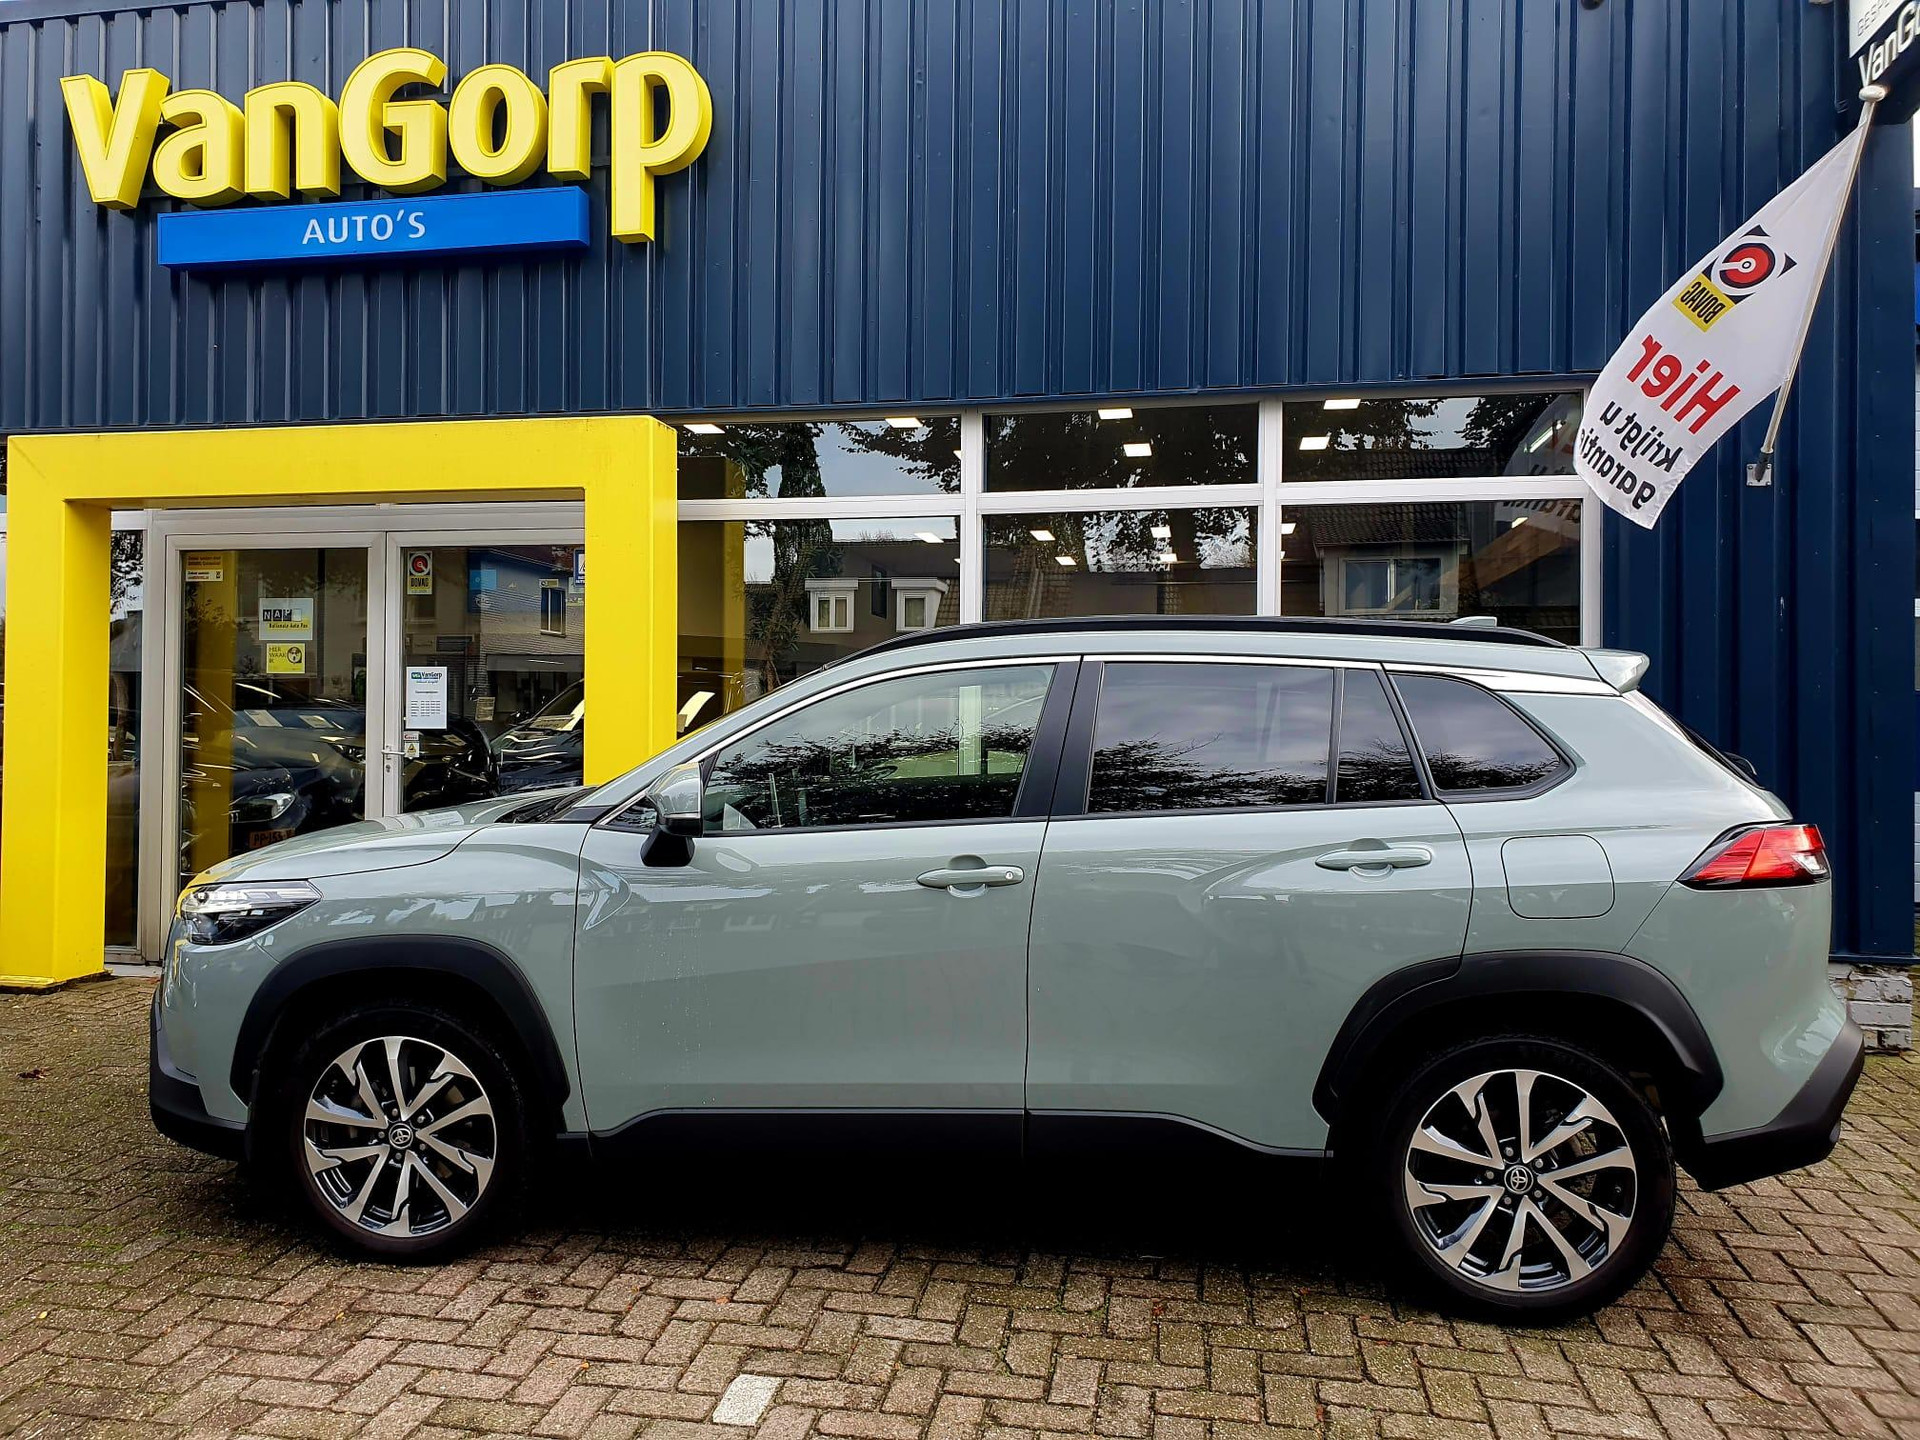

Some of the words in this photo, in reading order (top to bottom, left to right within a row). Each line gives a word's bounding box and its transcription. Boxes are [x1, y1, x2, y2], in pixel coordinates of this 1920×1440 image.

[1858, 0, 1920, 87] VanG
[59, 47, 713, 244] VanGorp
[301, 209, 427, 245] AUTO'S
